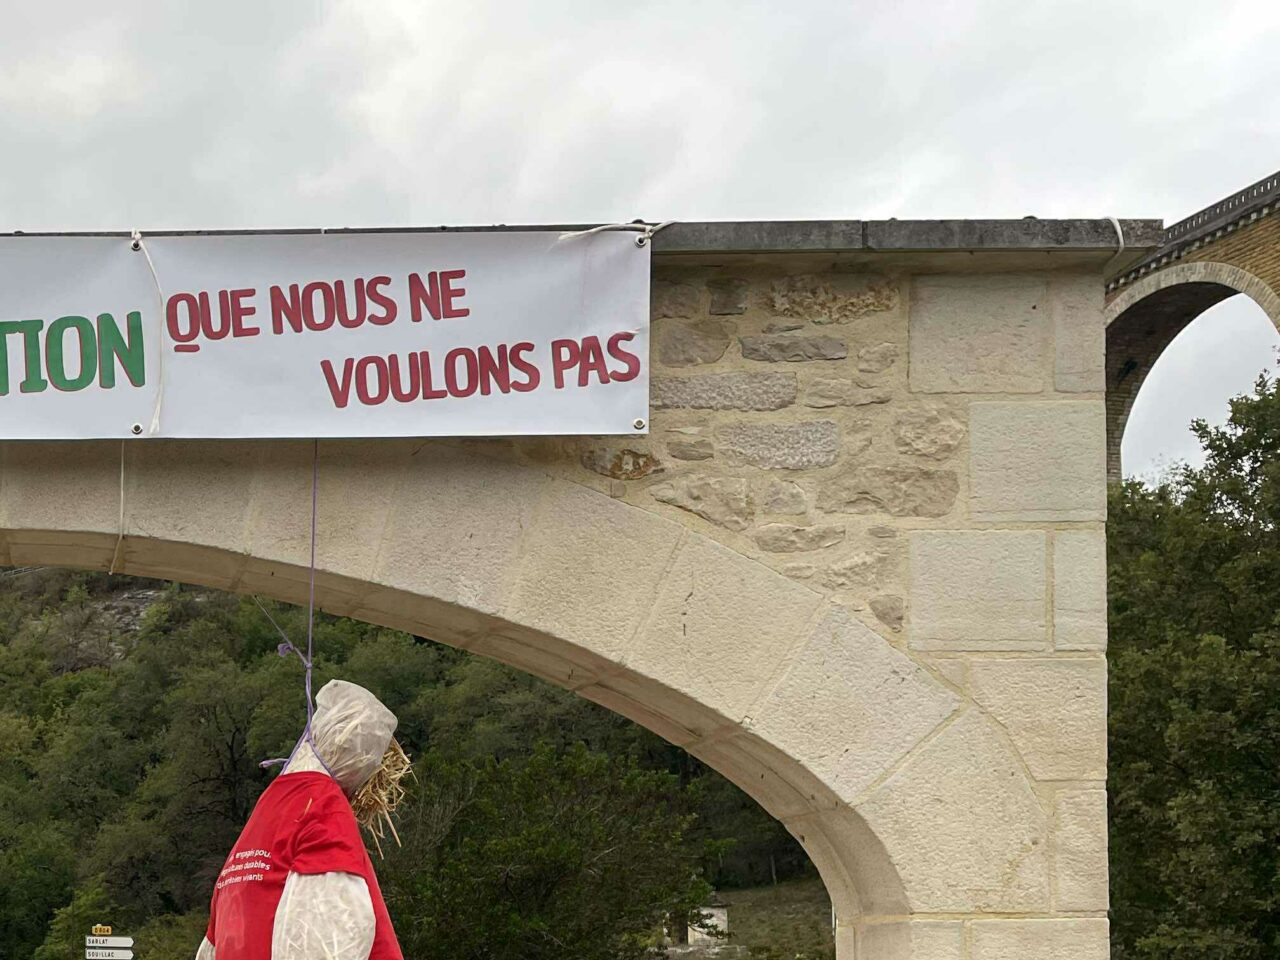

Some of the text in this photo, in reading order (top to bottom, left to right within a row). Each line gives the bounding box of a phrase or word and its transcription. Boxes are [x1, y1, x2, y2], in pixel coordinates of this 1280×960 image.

[165, 268, 472, 353] QUE NOUS NE
[320, 331, 643, 409] VOULONS PAS
